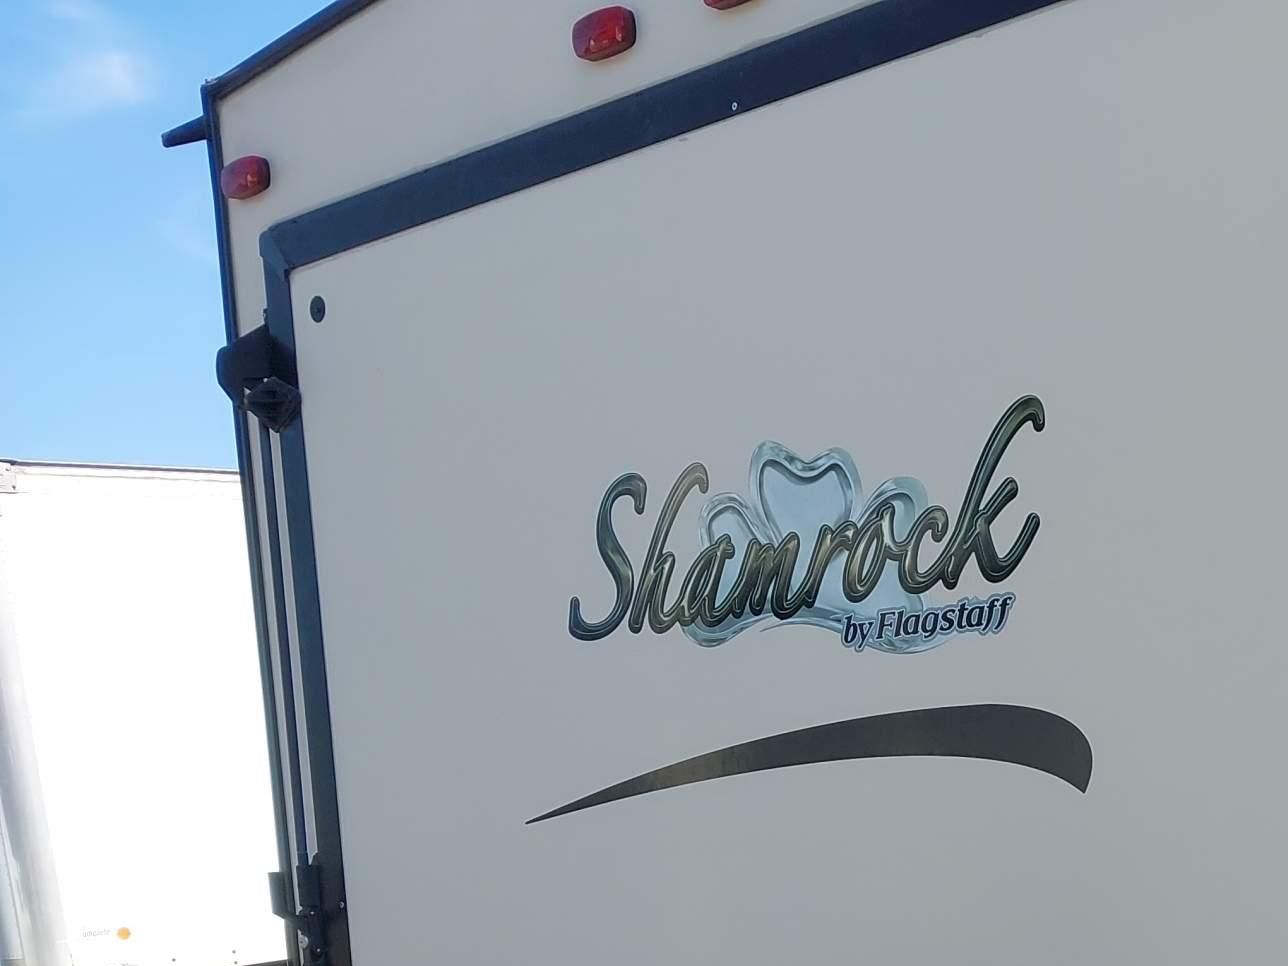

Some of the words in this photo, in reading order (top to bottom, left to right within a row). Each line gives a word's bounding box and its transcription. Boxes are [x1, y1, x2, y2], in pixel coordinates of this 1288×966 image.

[568, 394, 1045, 641] Shamrock
[843, 614, 874, 649] by
[875, 596, 1013, 640] Flagstaff
